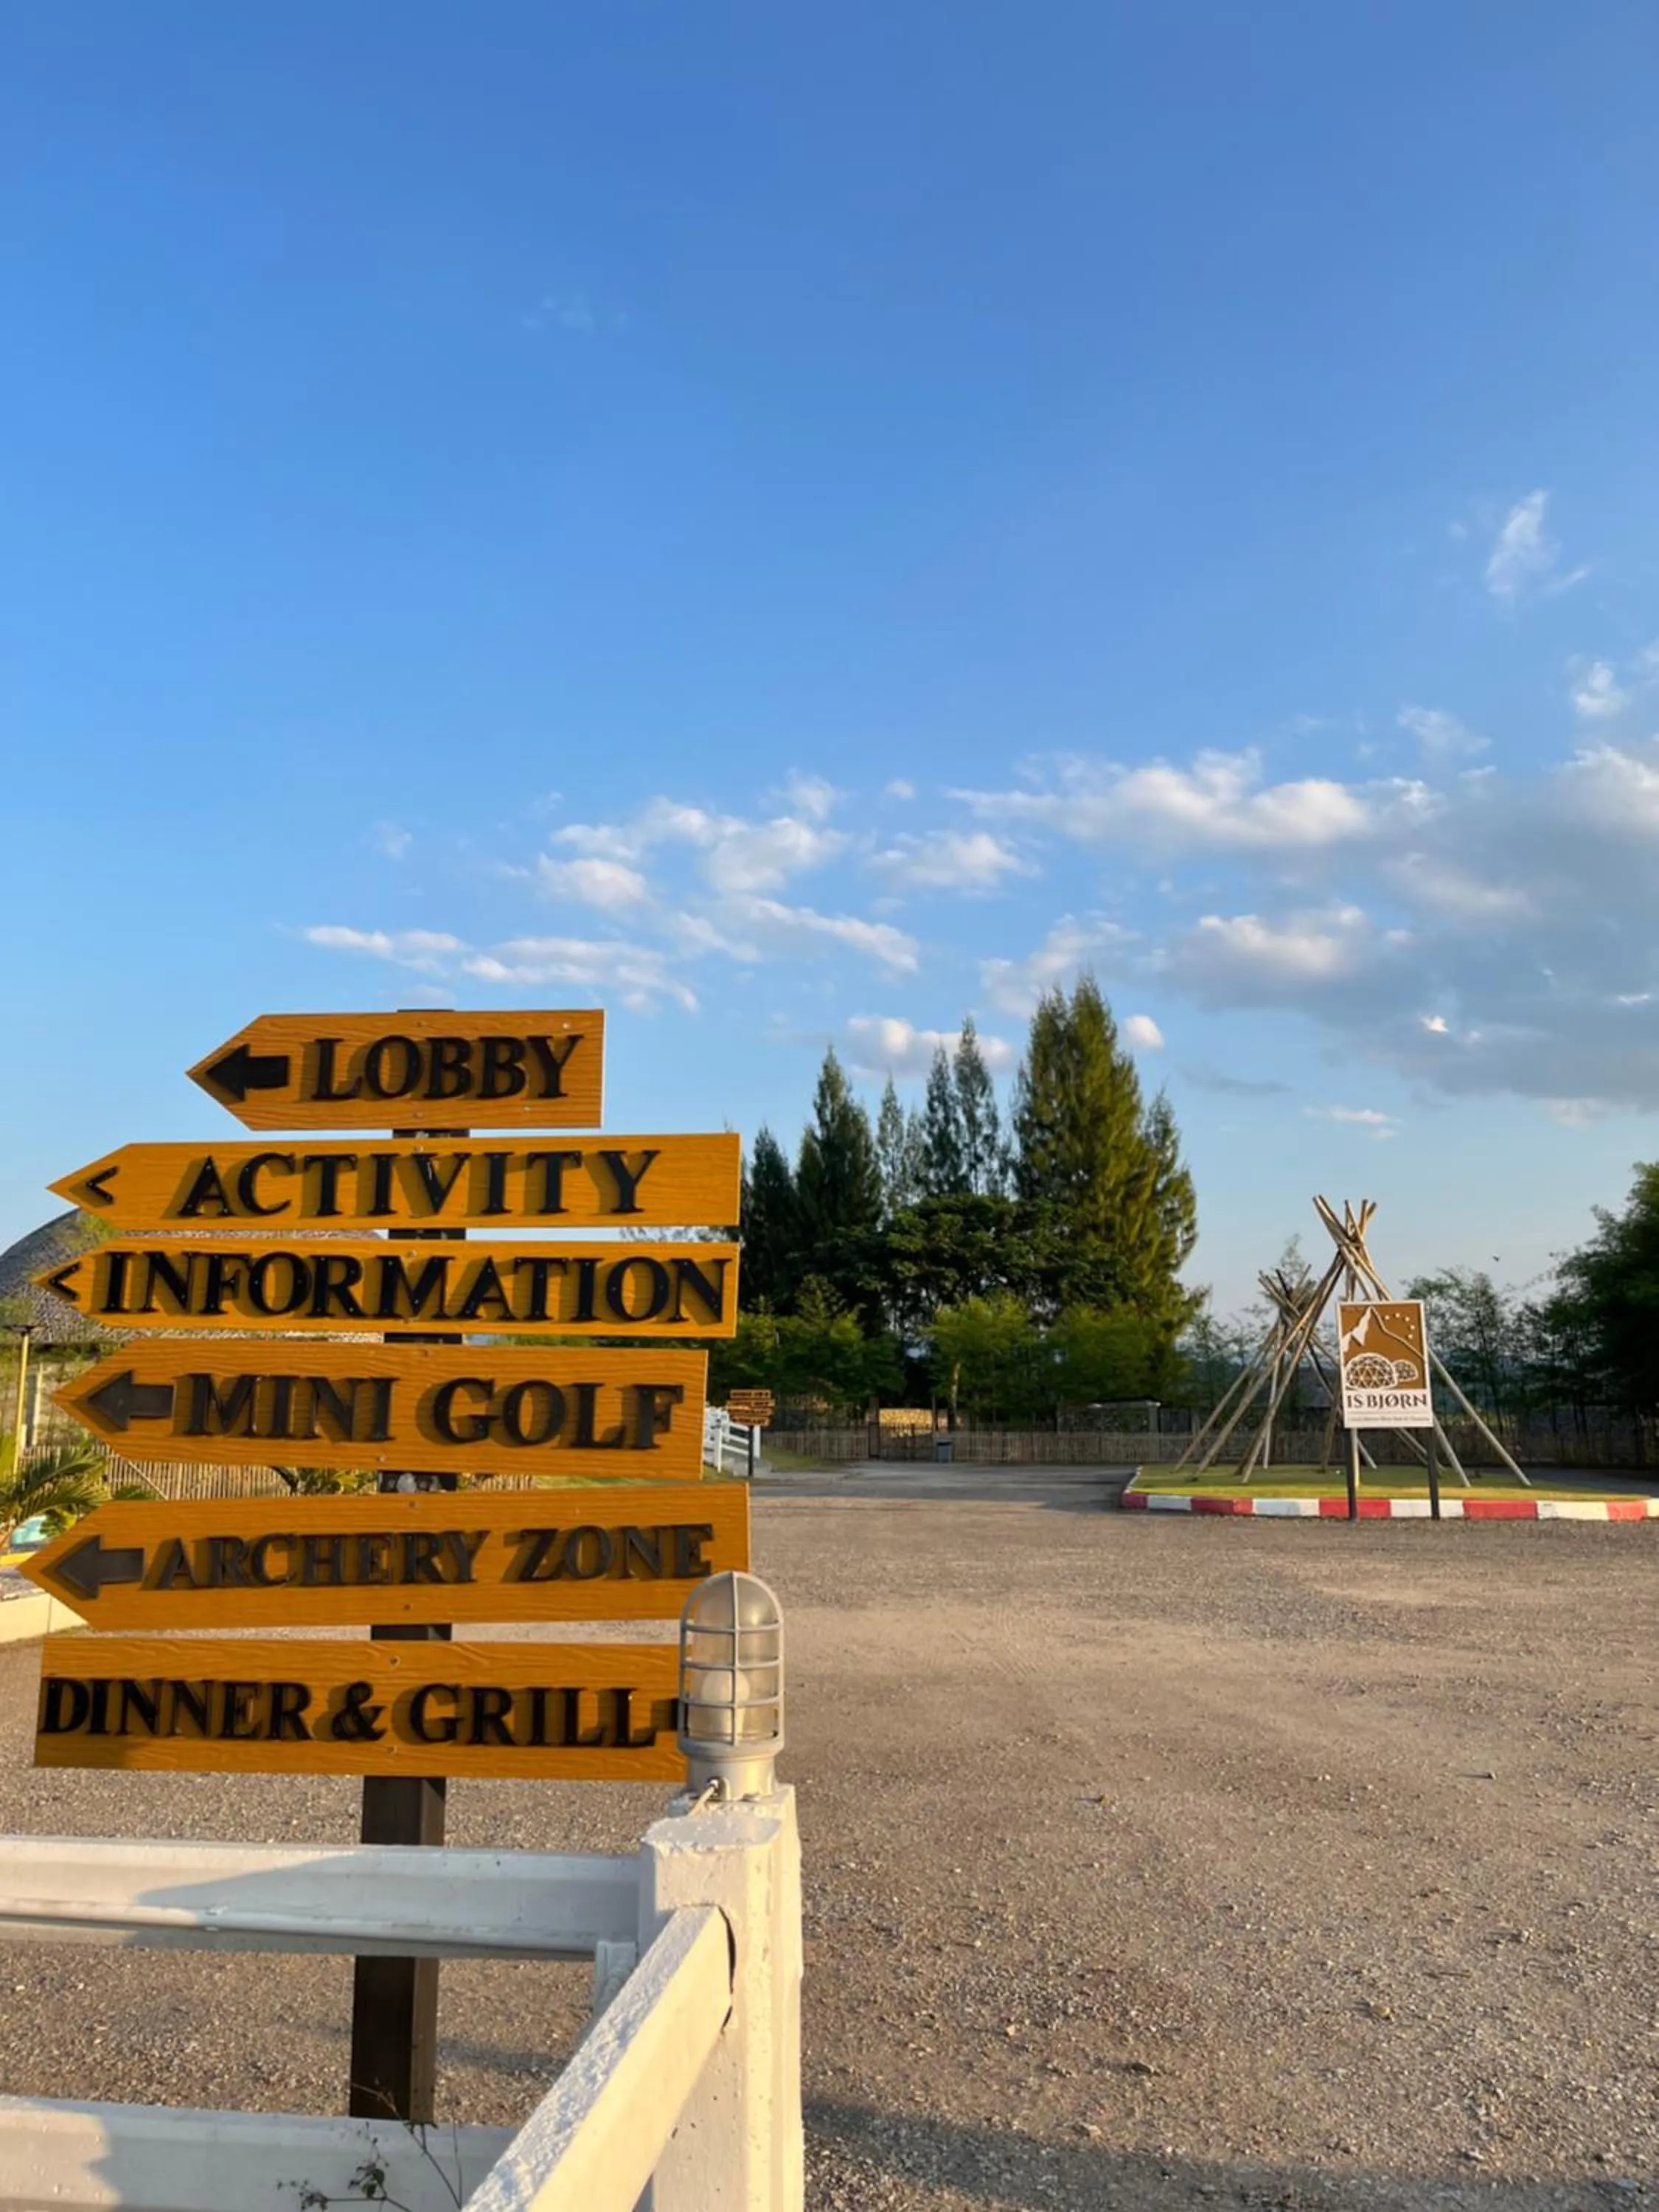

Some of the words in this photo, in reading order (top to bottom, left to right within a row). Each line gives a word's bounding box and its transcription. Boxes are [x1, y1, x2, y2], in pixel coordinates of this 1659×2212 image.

[311, 1034, 584, 1101] LOBBY
[178, 1150, 661, 1217] ACTIVITY
[101, 1251, 728, 1323] INFORMATION
[183, 1374, 400, 1443] MINI
[433, 1377, 684, 1450] GOLF
[155, 1530, 489, 1589] ARCHERY
[518, 1523, 713, 1582] ZONE
